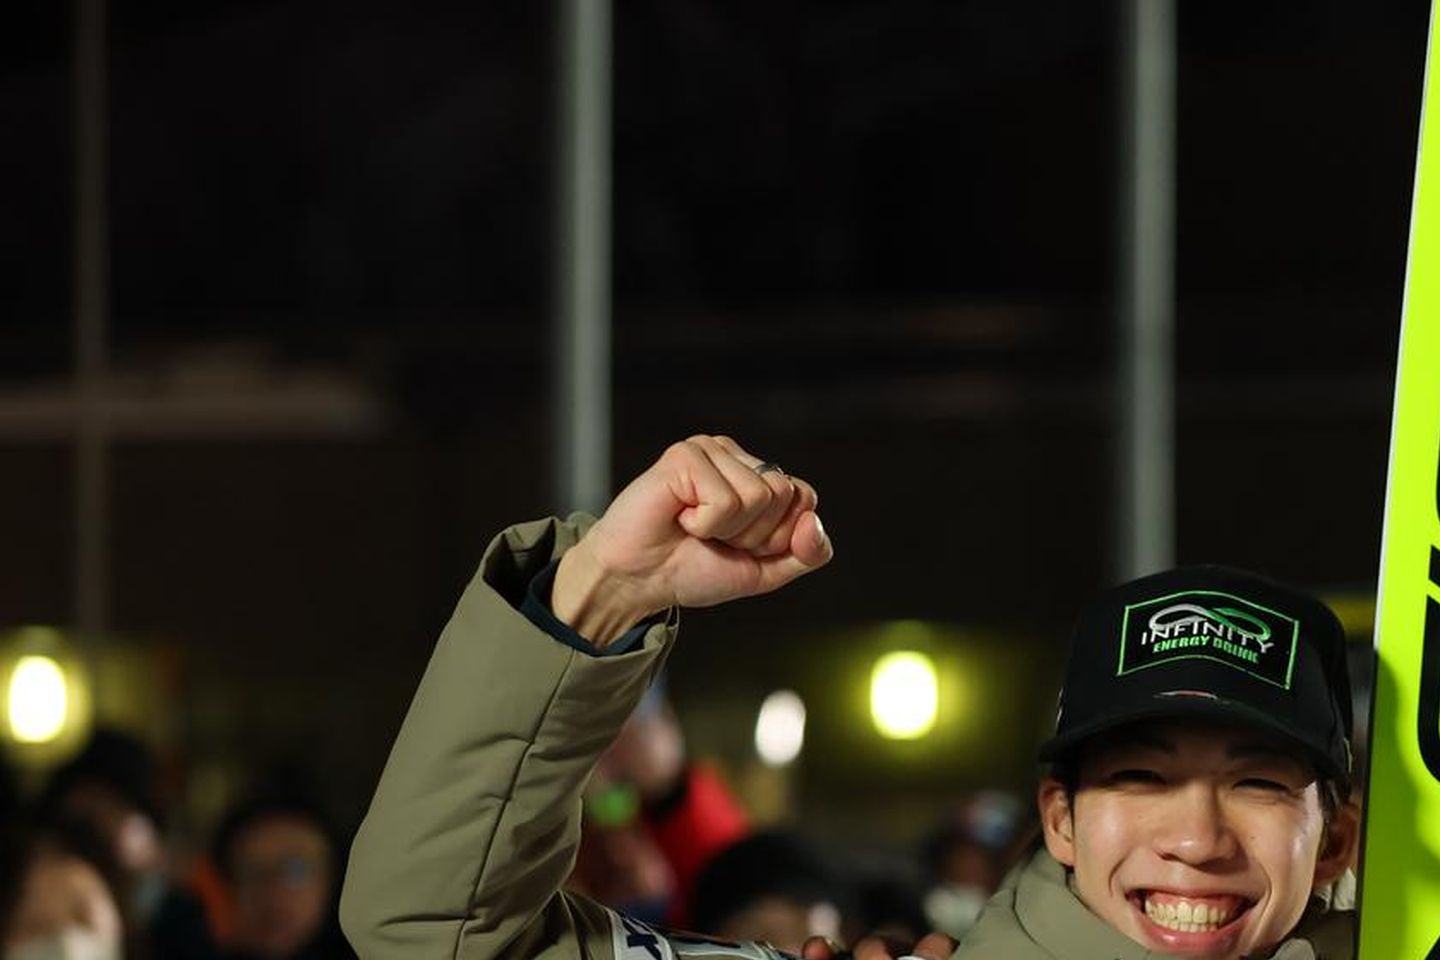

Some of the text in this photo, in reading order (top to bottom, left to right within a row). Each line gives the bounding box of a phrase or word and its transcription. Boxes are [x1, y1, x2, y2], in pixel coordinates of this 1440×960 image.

[1141, 620, 1274, 653] INFINITY
[1152, 635, 1259, 663] ENERGY DRINK
